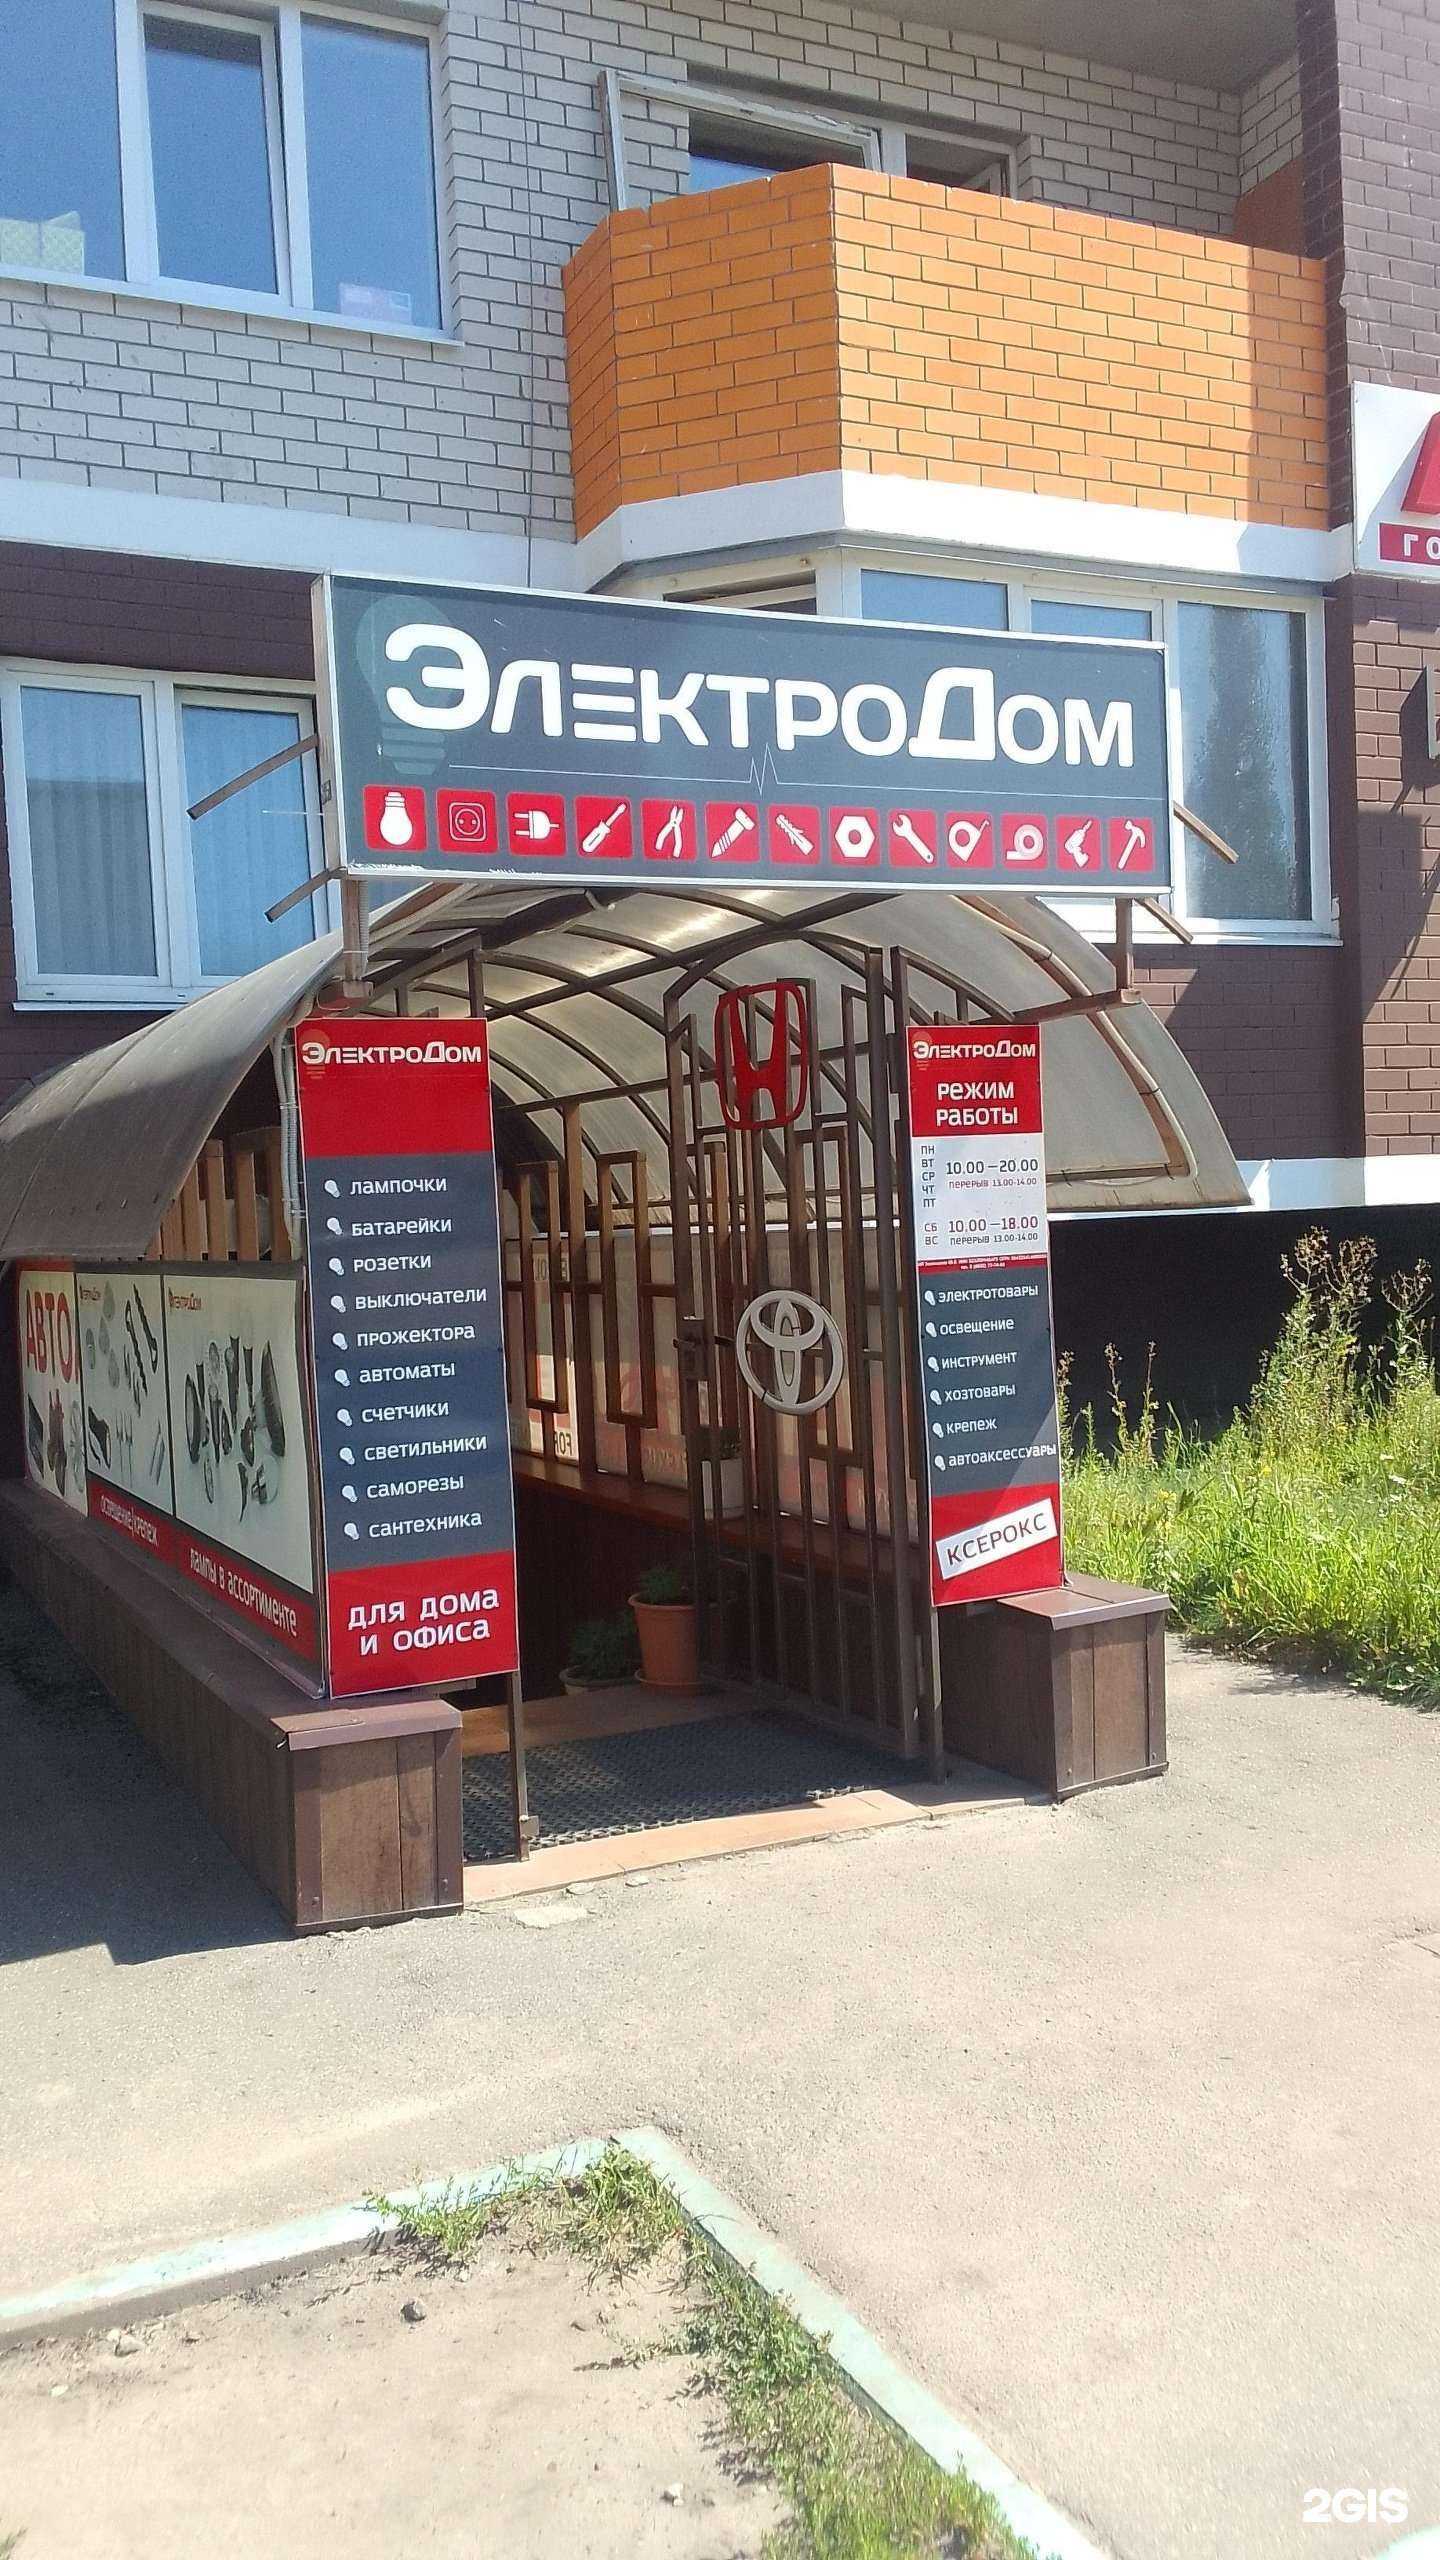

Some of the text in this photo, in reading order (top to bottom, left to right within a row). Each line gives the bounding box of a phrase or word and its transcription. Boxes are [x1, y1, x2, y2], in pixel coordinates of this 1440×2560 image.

[920, 1145, 935, 1155] ПН
[921, 1158, 935, 1168] ВТ
[349, 1176, 448, 1196] лампочки
[921, 1171, 936, 1181] СР
[923, 1198, 936, 1208] ПТ
[355, 1287, 487, 1311] выключатели
[26, 1288, 80, 1385] АВТО
[359, 1362, 456, 1384] автоматы
[361, 1402, 449, 1424] счетчики
[364, 1435, 488, 1462] светильники
[368, 1510, 482, 1539] сантехника
[946, 1513, 1048, 1570] КСЕРОКС
